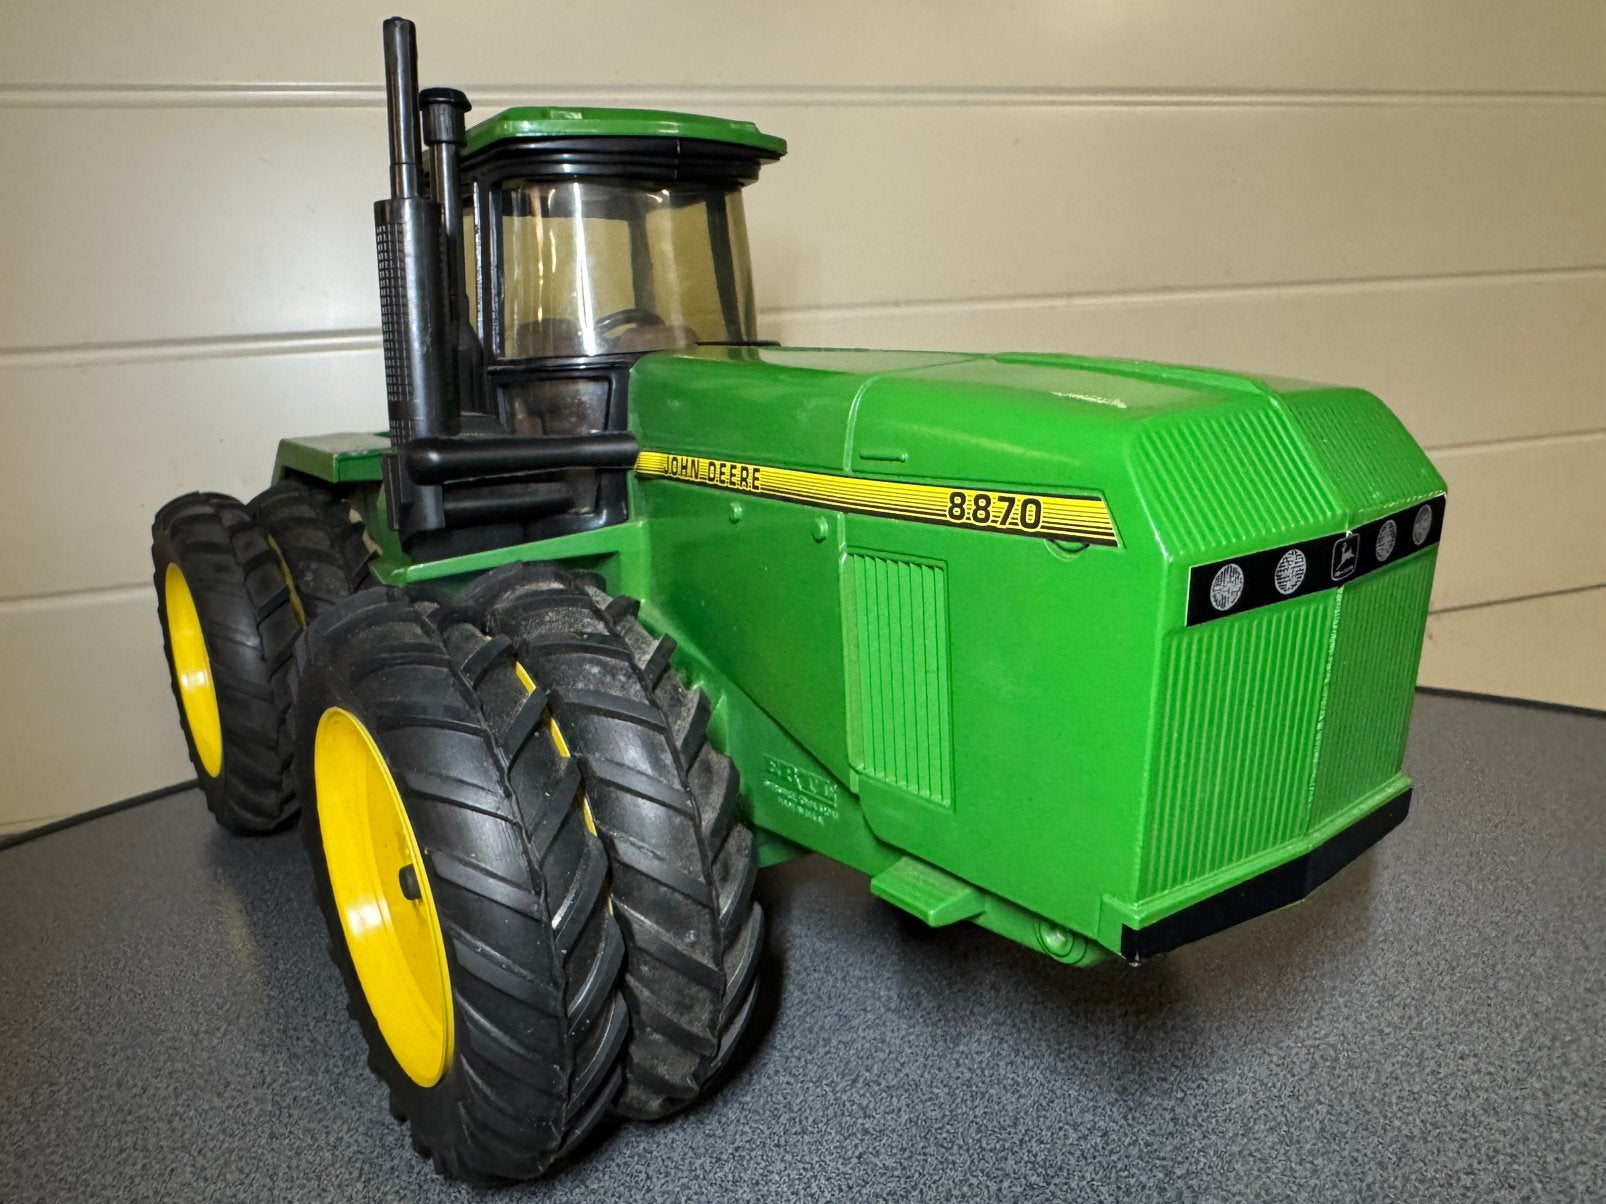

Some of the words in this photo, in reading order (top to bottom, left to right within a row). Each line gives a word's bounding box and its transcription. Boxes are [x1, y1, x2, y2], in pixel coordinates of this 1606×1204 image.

[664, 456, 700, 480] JOHN
[707, 461, 761, 490] DEERE
[948, 491, 1042, 530] 8870
